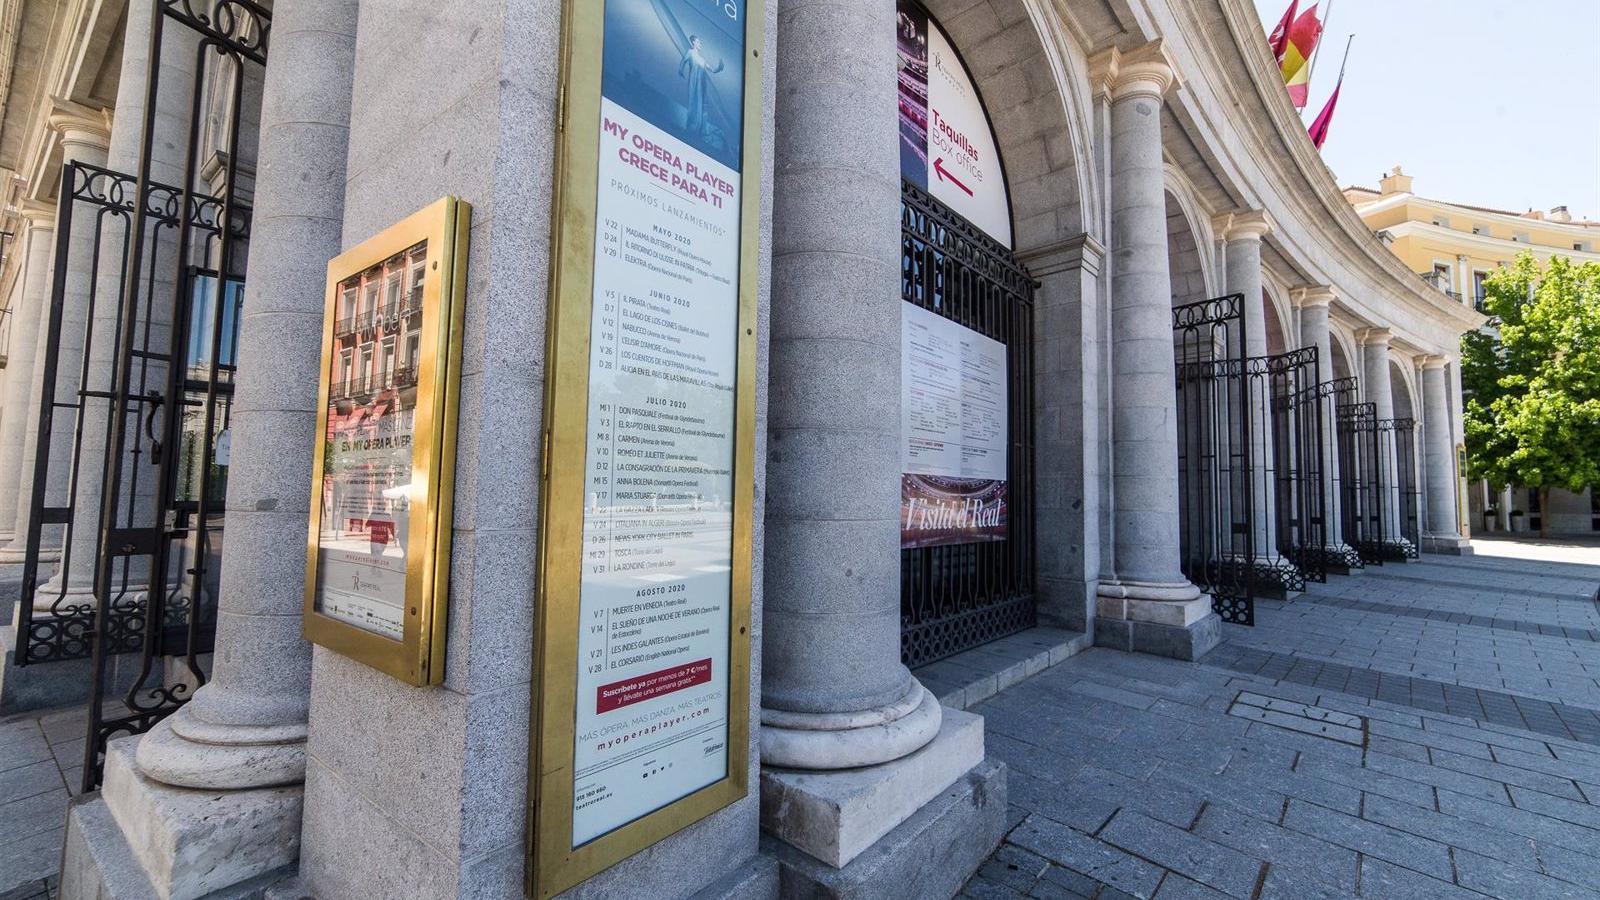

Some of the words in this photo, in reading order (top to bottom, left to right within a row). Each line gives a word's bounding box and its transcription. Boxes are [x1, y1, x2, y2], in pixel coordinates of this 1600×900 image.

[932, 108, 979, 161] Taquillas
[604, 117, 628, 142] MY
[632, 133, 682, 171] OPERA
[686, 162, 734, 198] PLAYER
[932, 127, 953, 157] Box
[956, 150, 983, 182] office
[619, 146, 668, 183] CRECE
[672, 173, 708, 202] PARA
[711, 194, 722, 209] TI
[605, 219, 610, 228] V
[612, 221, 618, 230] 22
[605, 233, 610, 241] D
[610, 235, 617, 244] 24
[653, 224, 671, 238] MAYO
[675, 233, 691, 246] 2020
[604, 247, 609, 255] V
[610, 249, 616, 257] 29
[650, 290, 670, 302] JUNIO
[674, 297, 690, 308] 2020
[622, 350, 631, 359] LOS
[638, 367, 645, 375] EN
[646, 397, 667, 406] JULIO
[670, 400, 686, 409] 2020
[619, 407, 631, 415] DON
[632, 408, 657, 419] PASQUALE
[619, 421, 625, 429] EL
[652, 424, 657, 432] EL
[353, 440, 363, 451] MY
[618, 435, 640, 444] CARMEN
[638, 450, 644, 458] ET
[644, 451, 665, 459] JULIETTE
[906, 497, 953, 531] Visita
[970, 498, 1002, 528] Real
[615, 549, 631, 557] TOSCA
[614, 564, 622, 572] LA
[637, 587, 665, 597] AGOSTO
[669, 584, 685, 593] 2020
[613, 605, 634, 616] MUERTE
[635, 604, 641, 612] EN
[643, 601, 663, 611] VENECIA
[612, 622, 618, 631] EL
[639, 617, 645, 626] DE
[646, 615, 656, 624] UNA
[658, 613, 674, 622] NOCHE
[674, 611, 681, 619] DE
[682, 608, 700, 618] VERANO
[611, 645, 621, 654] LES
[622, 642, 638, 652] INDES
[639, 636, 664, 649] GALANTES
[589, 666, 594, 674] V
[595, 664, 602, 672] 28
[611, 661, 617, 669] EL
[618, 655, 644, 668] CORSARIO
[638, 681, 646, 690] ya
[647, 678, 658, 688] por
[659, 673, 677, 683] menos
[644, 688, 654, 696] una
[656, 681, 677, 693] semana
[597, 706, 709, 752] myoperaplayer.com
